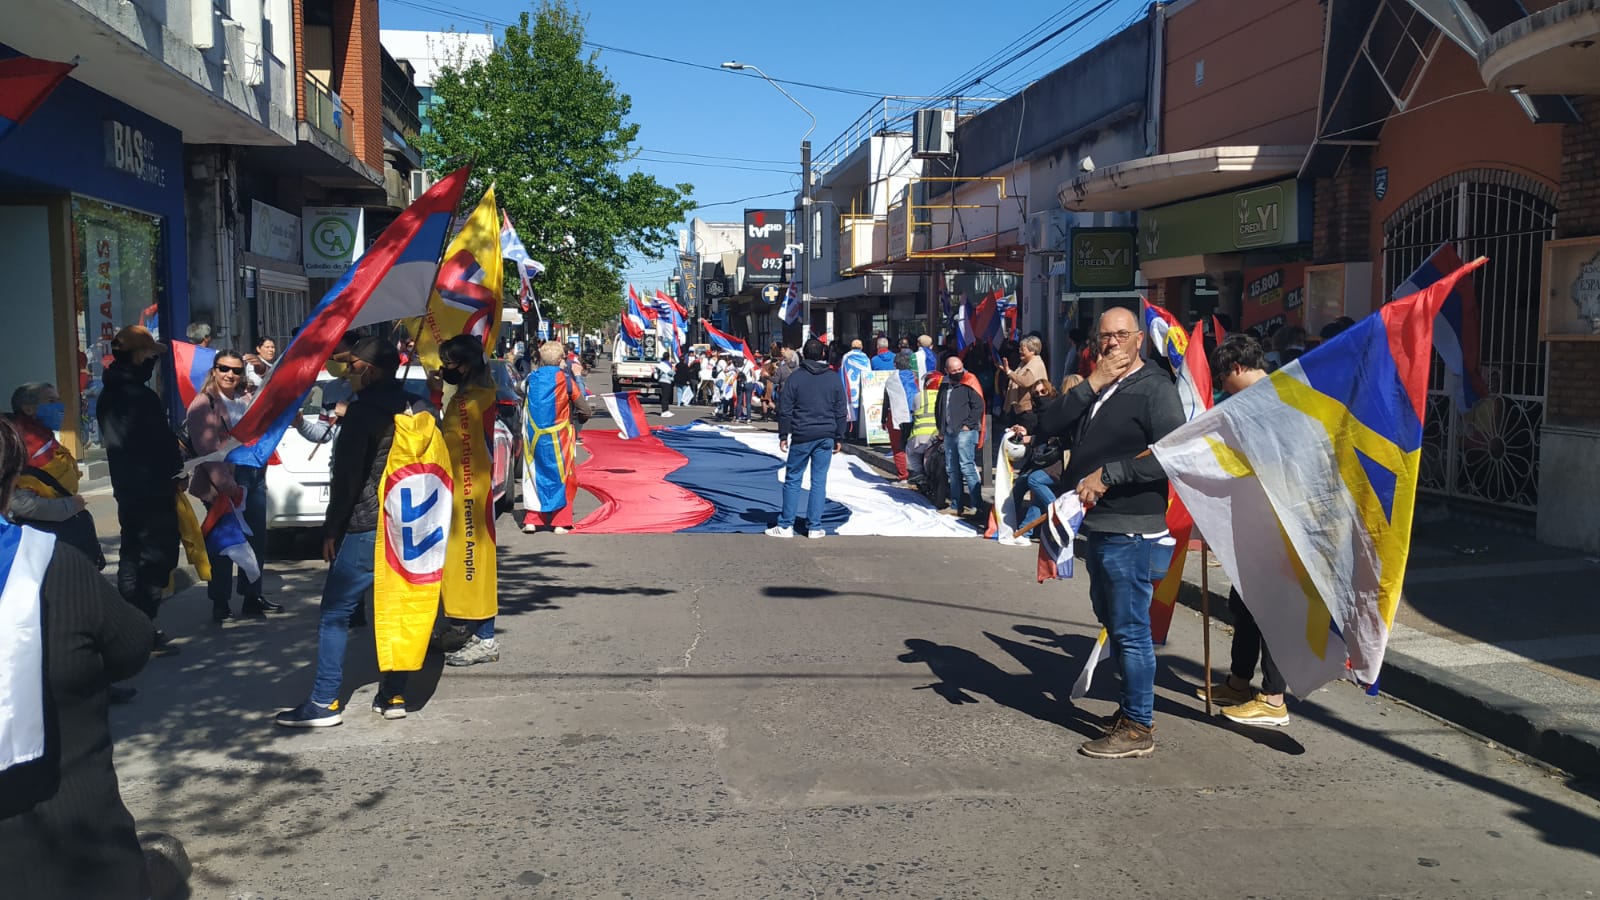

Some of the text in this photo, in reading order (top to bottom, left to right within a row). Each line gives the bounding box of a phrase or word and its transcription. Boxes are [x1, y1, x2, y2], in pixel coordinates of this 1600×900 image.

[113, 121, 145, 177] BAS
[1256, 203, 1278, 231] YI
[320, 229, 346, 252] CA
[761, 258, 783, 270] 89.3
[1102, 248, 1130, 266] YI
[1251, 271, 1279, 297] 15.800
[460, 432, 473, 496] Artiguista
[463, 498, 475, 538] Frente
[463, 540, 476, 582] Amplio
